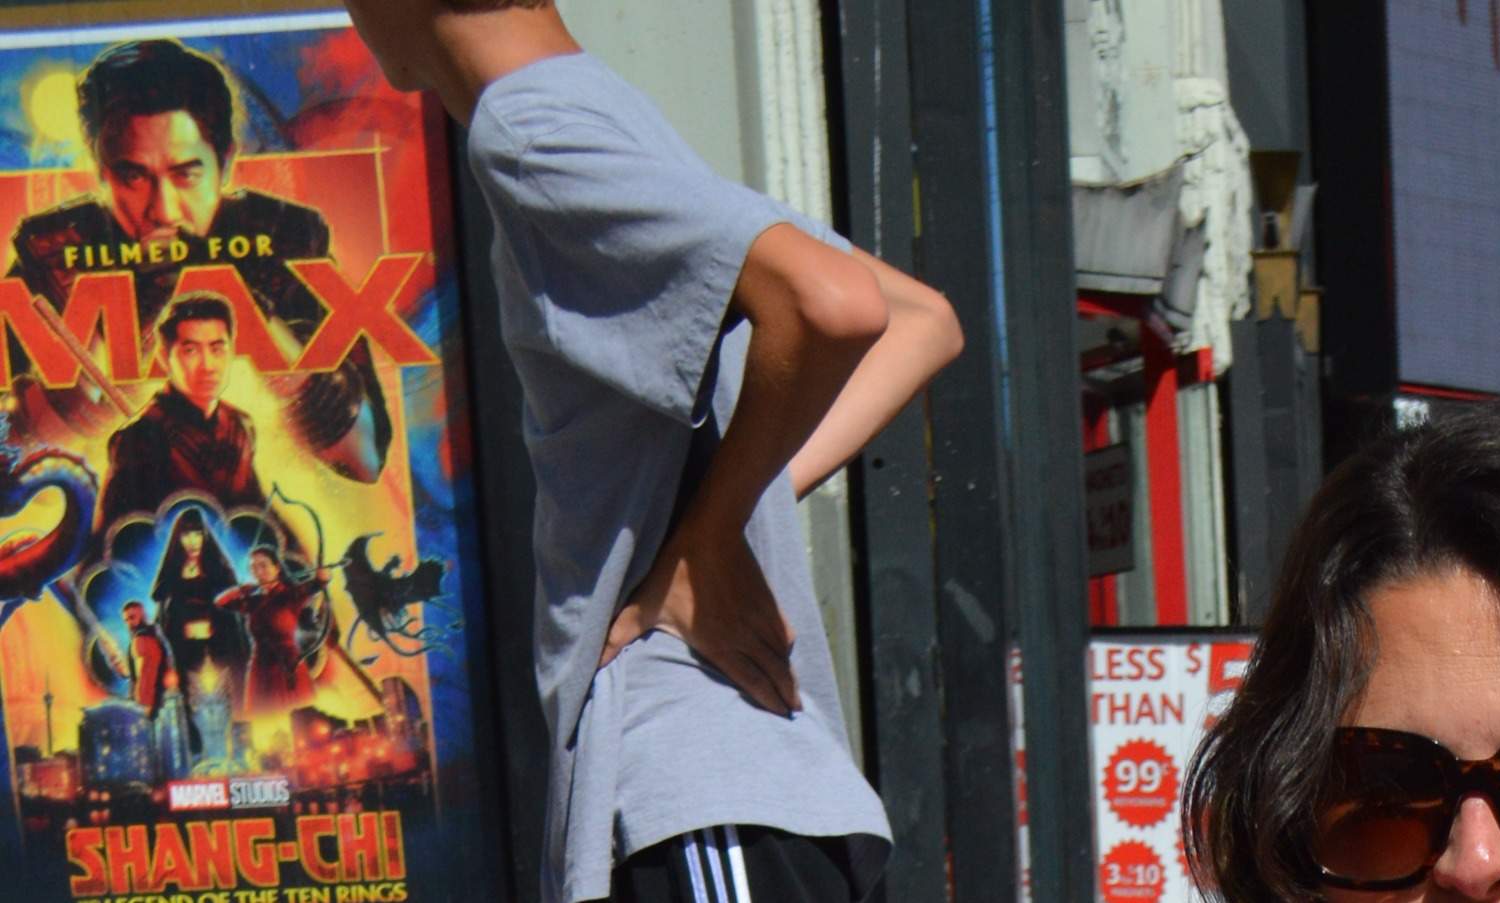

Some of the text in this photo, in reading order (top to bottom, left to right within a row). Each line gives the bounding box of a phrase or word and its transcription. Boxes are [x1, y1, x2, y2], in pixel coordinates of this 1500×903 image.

[64, 234, 274, 269] FILMED FOR
[1087, 648, 1165, 681] LESS
[1089, 693, 1184, 725] THAN
[170, 779, 290, 807] MARVEL STUDIOS
[66, 810, 407, 898] SHANG-CHI
[282, 886, 330, 903] TEN
[335, 882, 407, 903] RINGS
